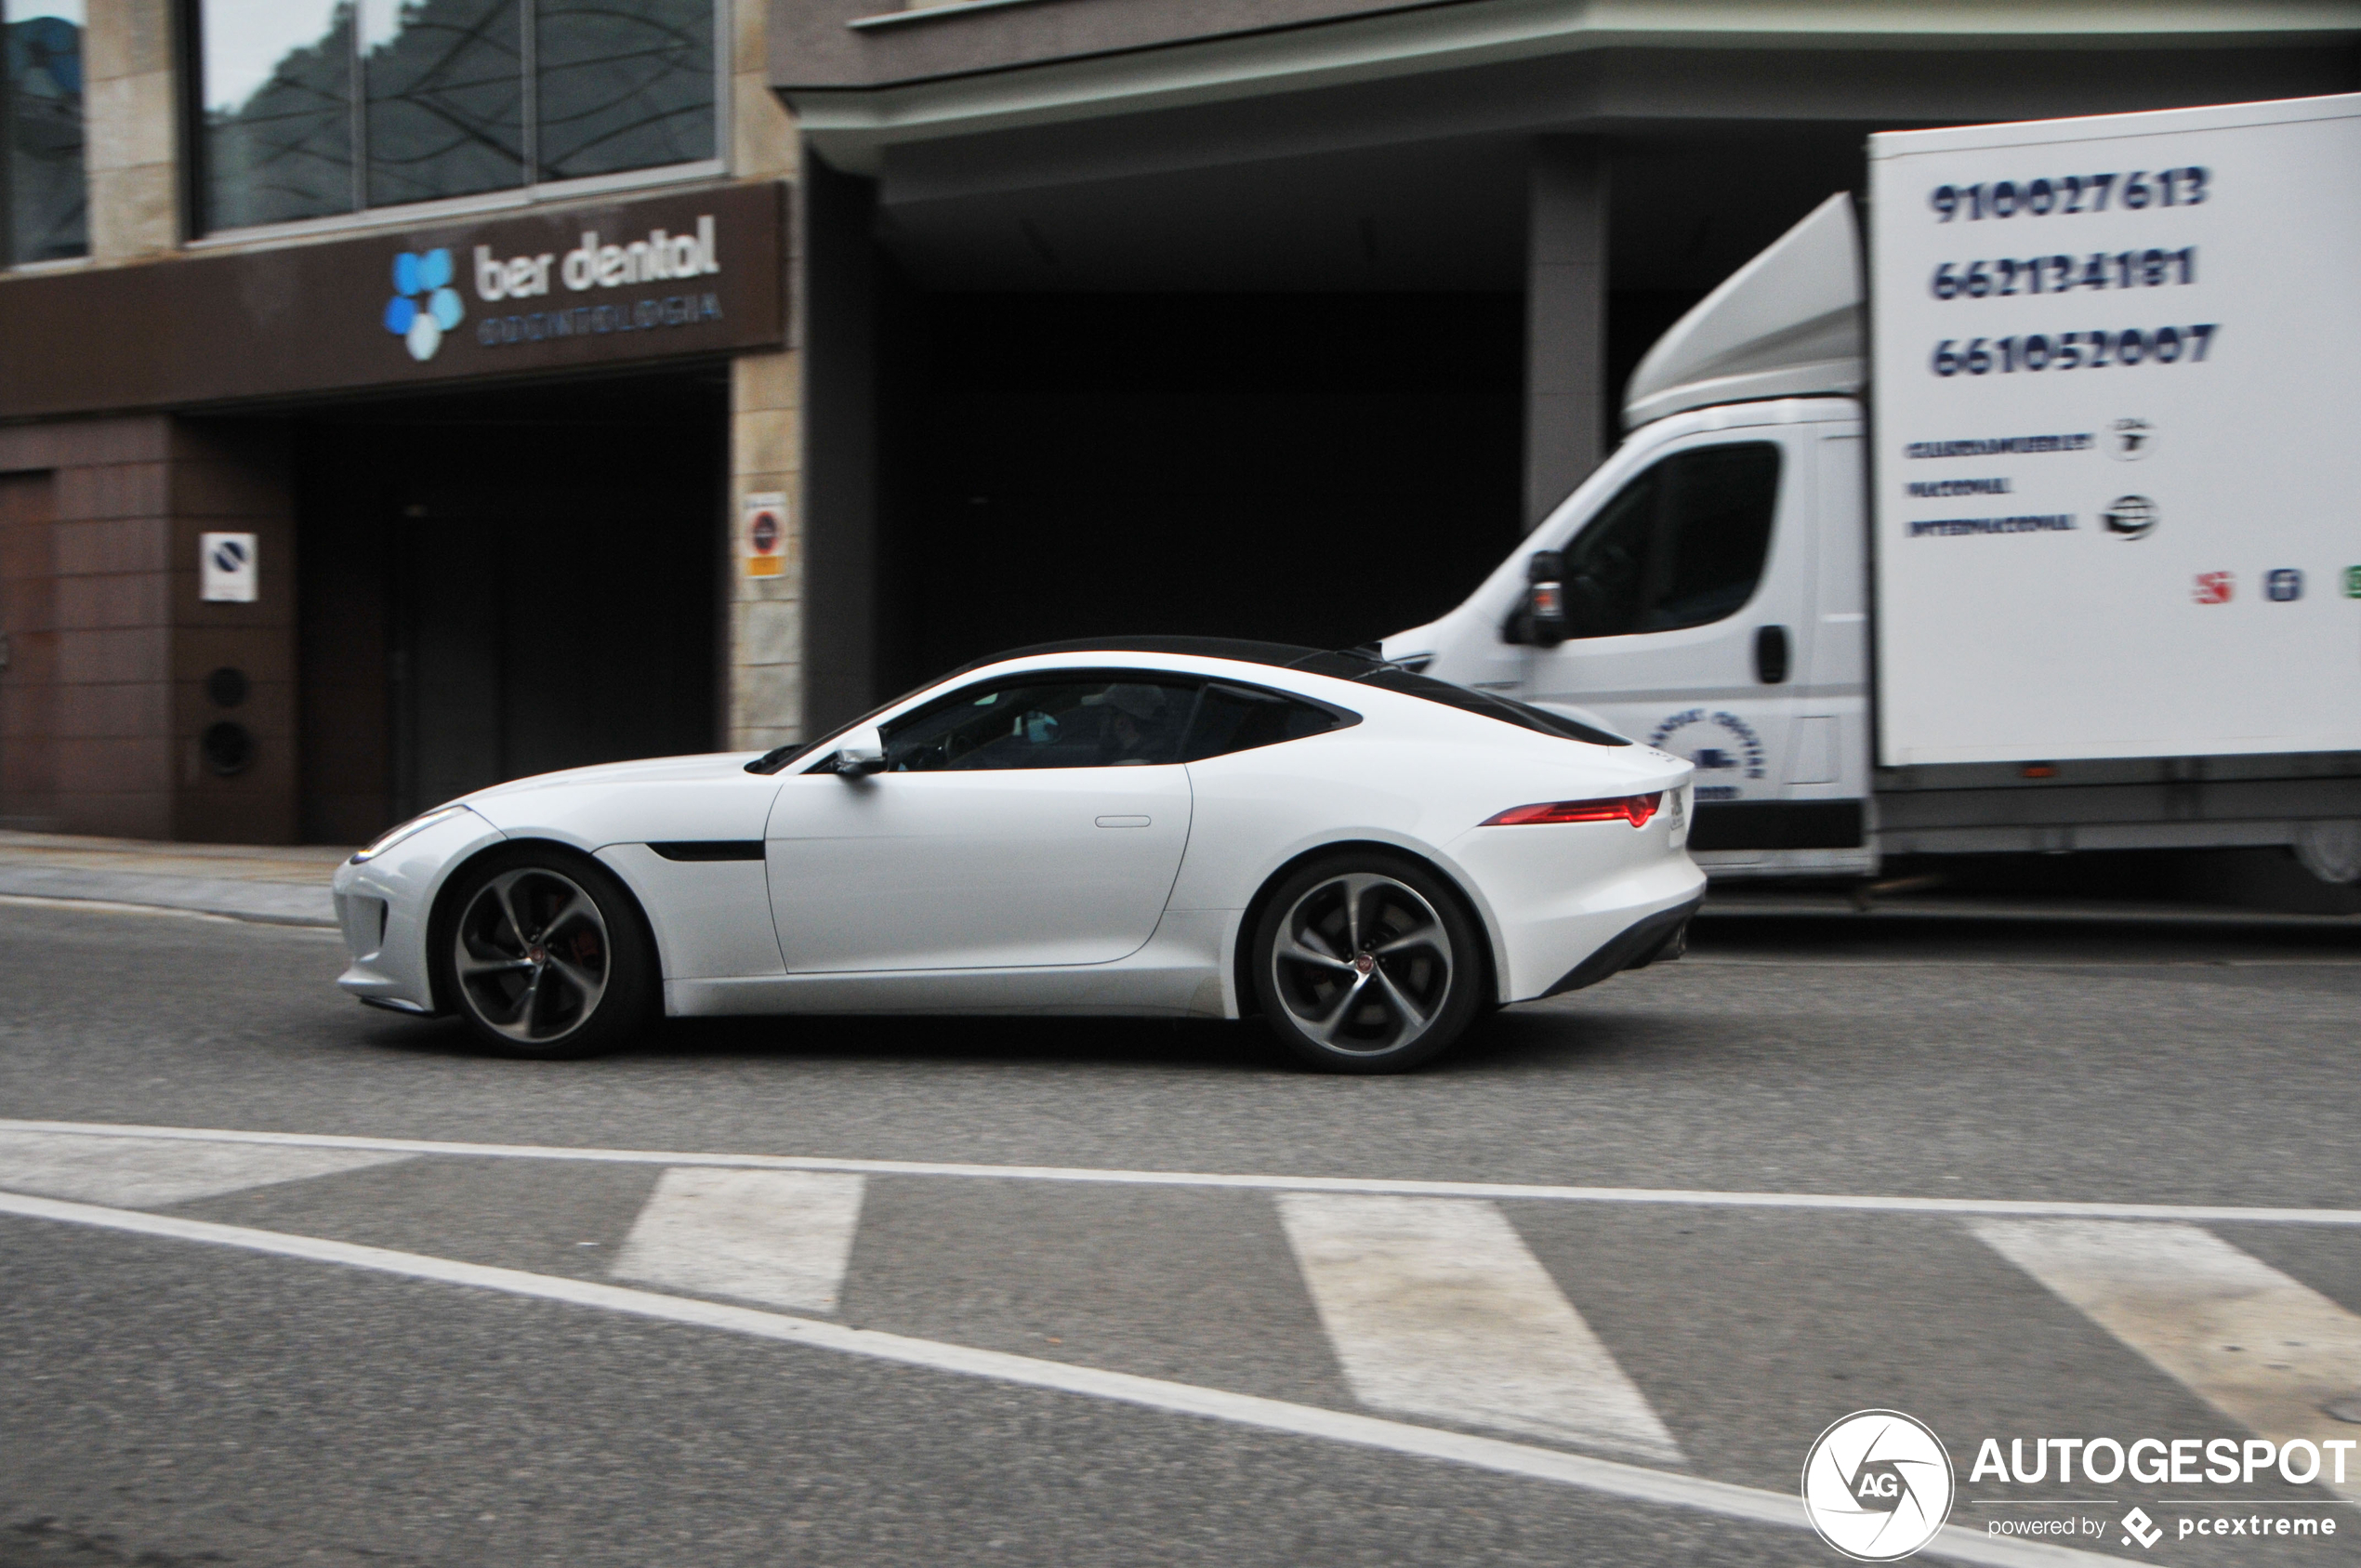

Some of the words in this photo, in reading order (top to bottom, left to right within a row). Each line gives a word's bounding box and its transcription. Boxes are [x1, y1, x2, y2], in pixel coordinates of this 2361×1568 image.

[1931, 165, 2210, 223] 910027613
[474, 244, 555, 301] ber
[561, 215, 719, 291] dental
[1932, 245, 2197, 300] 662134181
[476, 293, 723, 346] ODONTOLOGIA
[1931, 323, 2222, 377] 661052007
